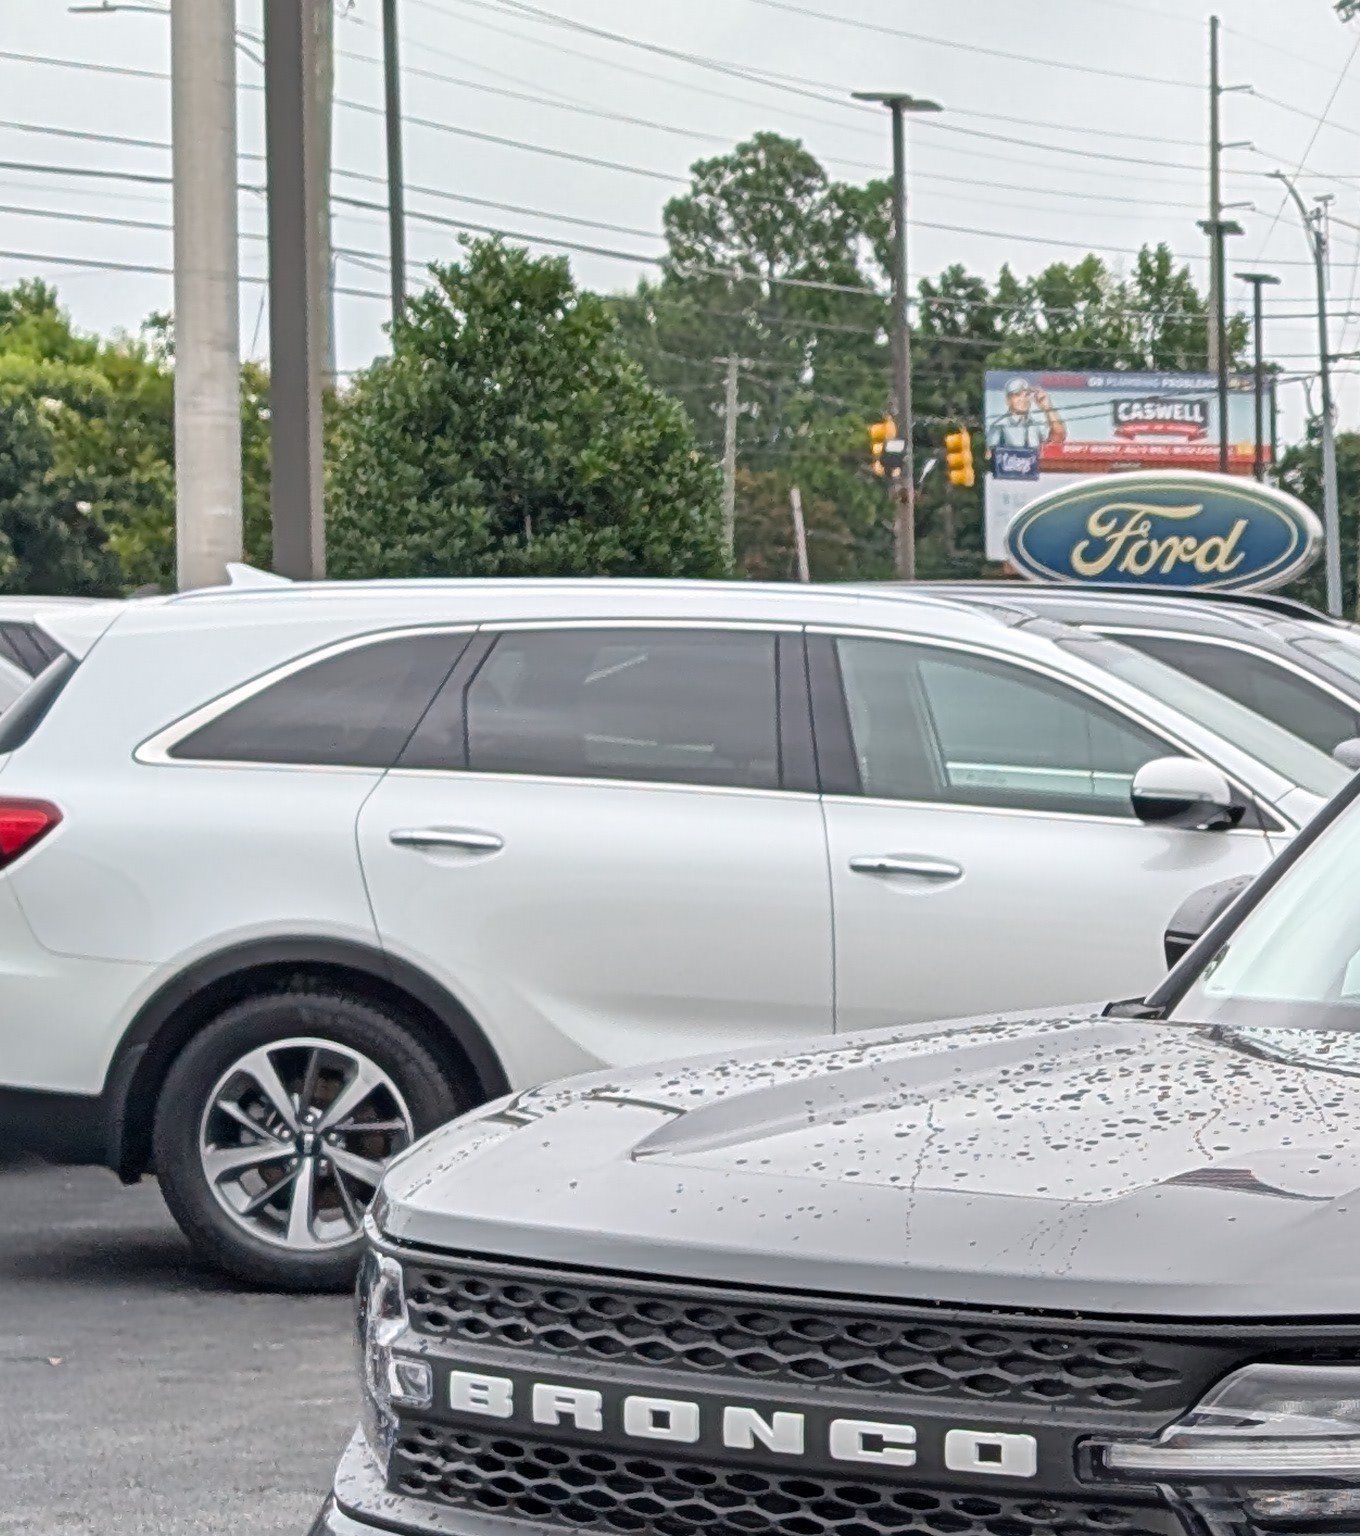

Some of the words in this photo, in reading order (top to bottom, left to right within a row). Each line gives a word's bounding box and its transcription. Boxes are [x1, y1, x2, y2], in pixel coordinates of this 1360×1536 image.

[1117, 402, 1205, 422] CASWELL
[1071, 502, 1249, 577] Ford
[448, 1369, 1038, 1479] BRONCO
